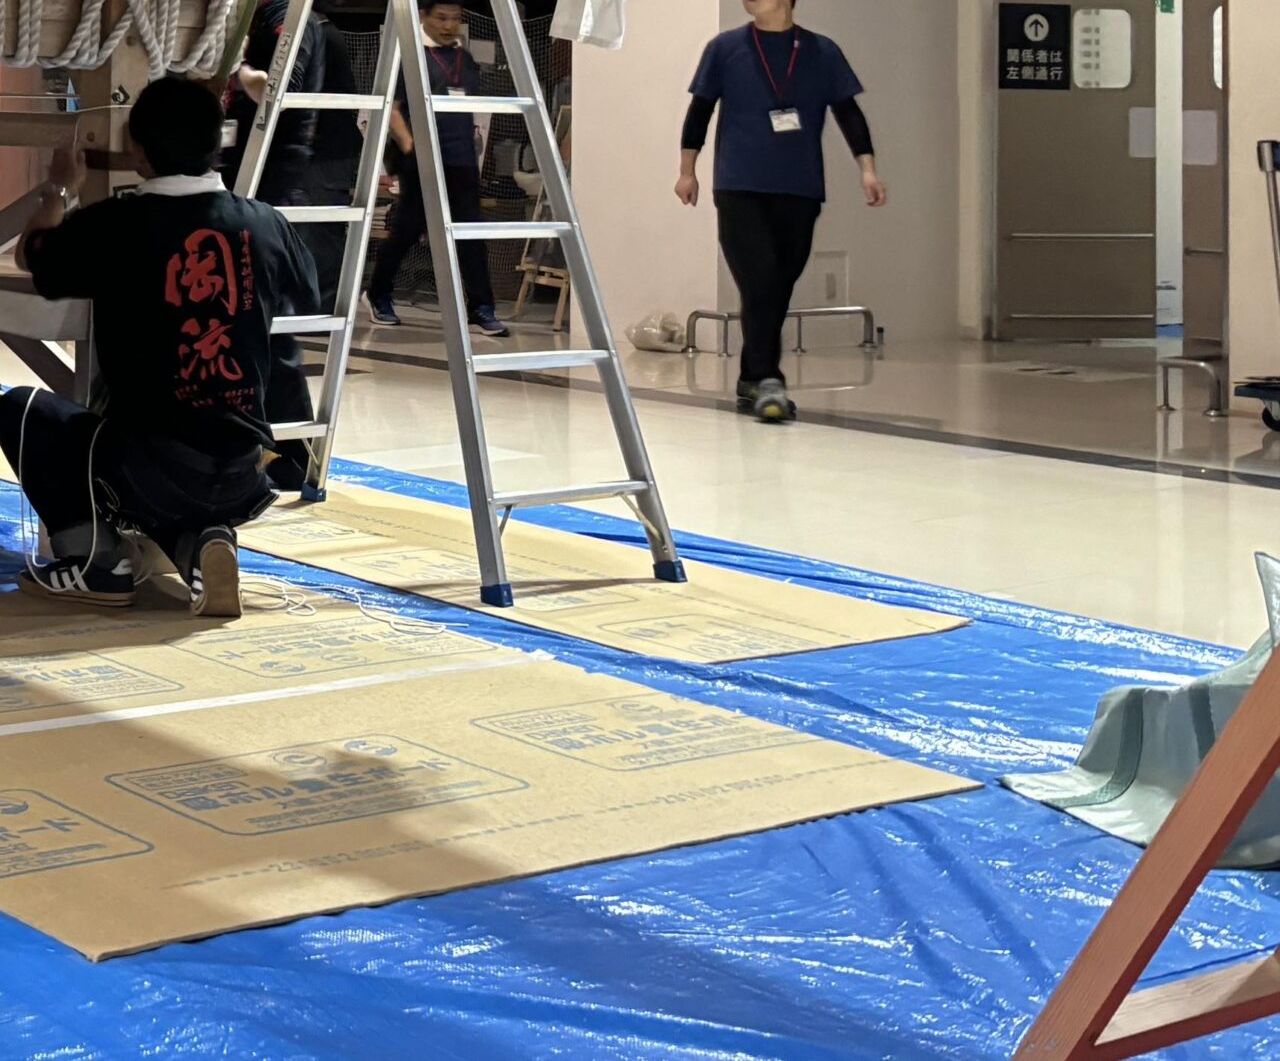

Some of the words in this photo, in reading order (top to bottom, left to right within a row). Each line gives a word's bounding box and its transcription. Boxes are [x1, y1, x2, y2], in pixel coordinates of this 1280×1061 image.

[1006, 48, 1063, 63] 関係者は
[1006, 66, 1063, 81] 左側通行
